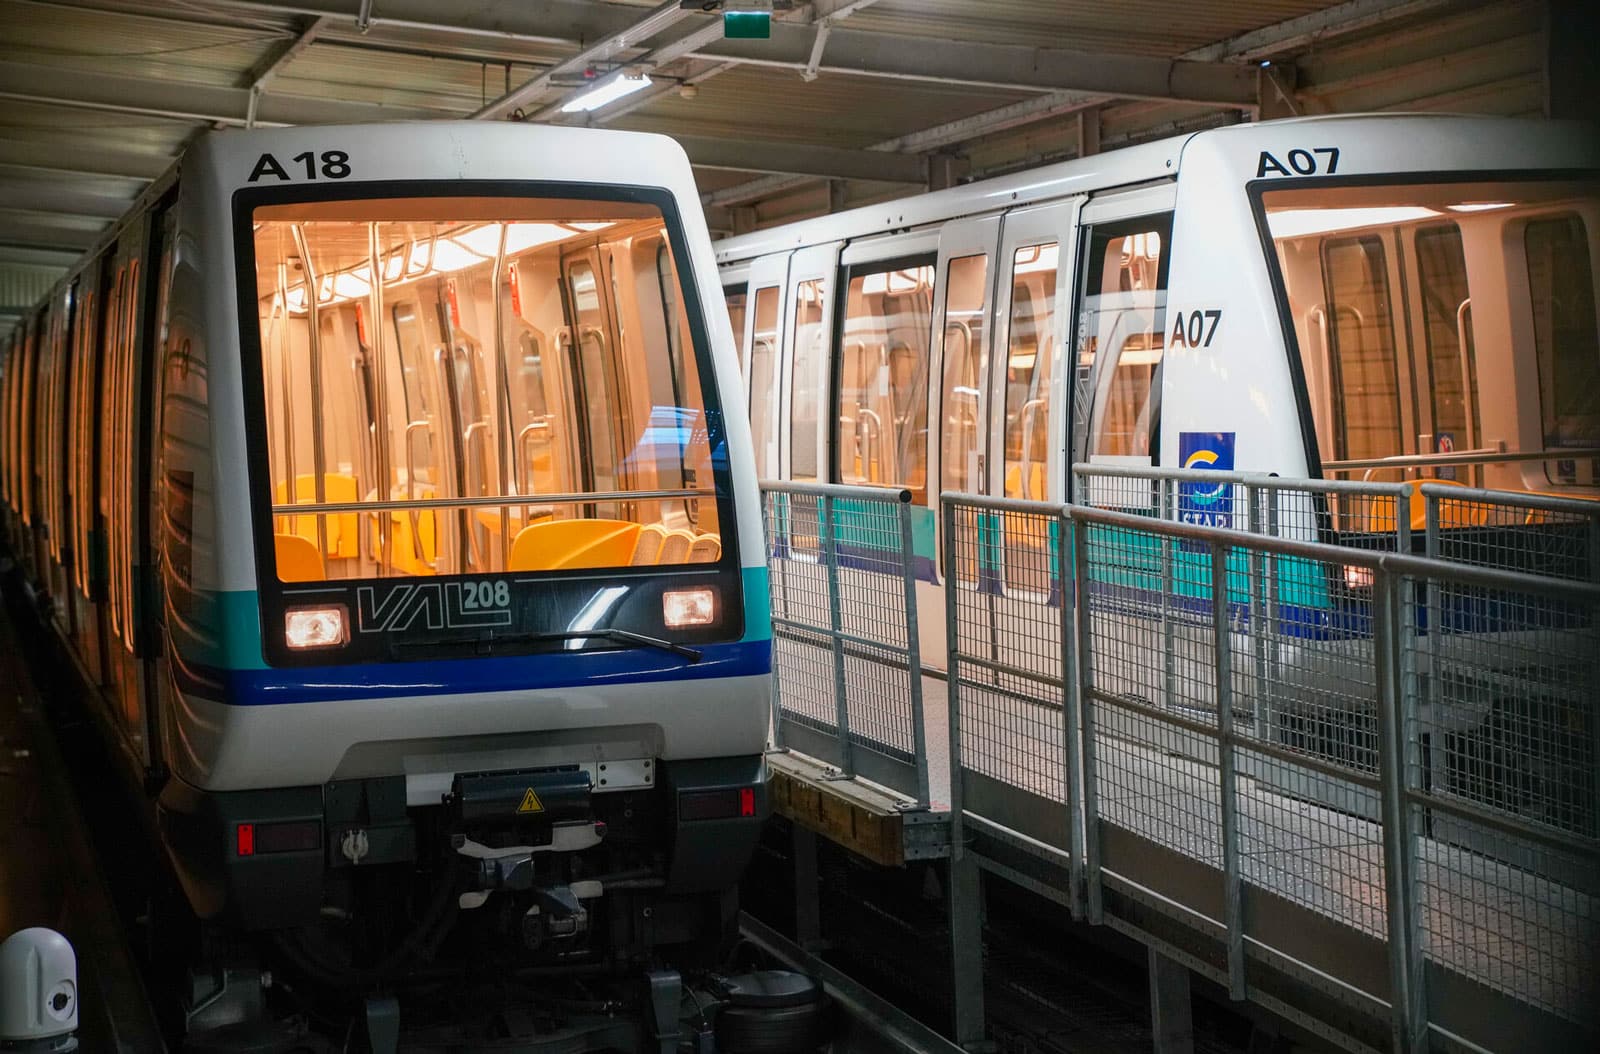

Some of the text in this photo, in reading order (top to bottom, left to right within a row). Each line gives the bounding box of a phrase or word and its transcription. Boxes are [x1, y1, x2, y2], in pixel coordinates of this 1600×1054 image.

[1257, 147, 1340, 177] A07
[1172, 309, 1222, 348] A07
[357, 581, 511, 633] VAL 208
